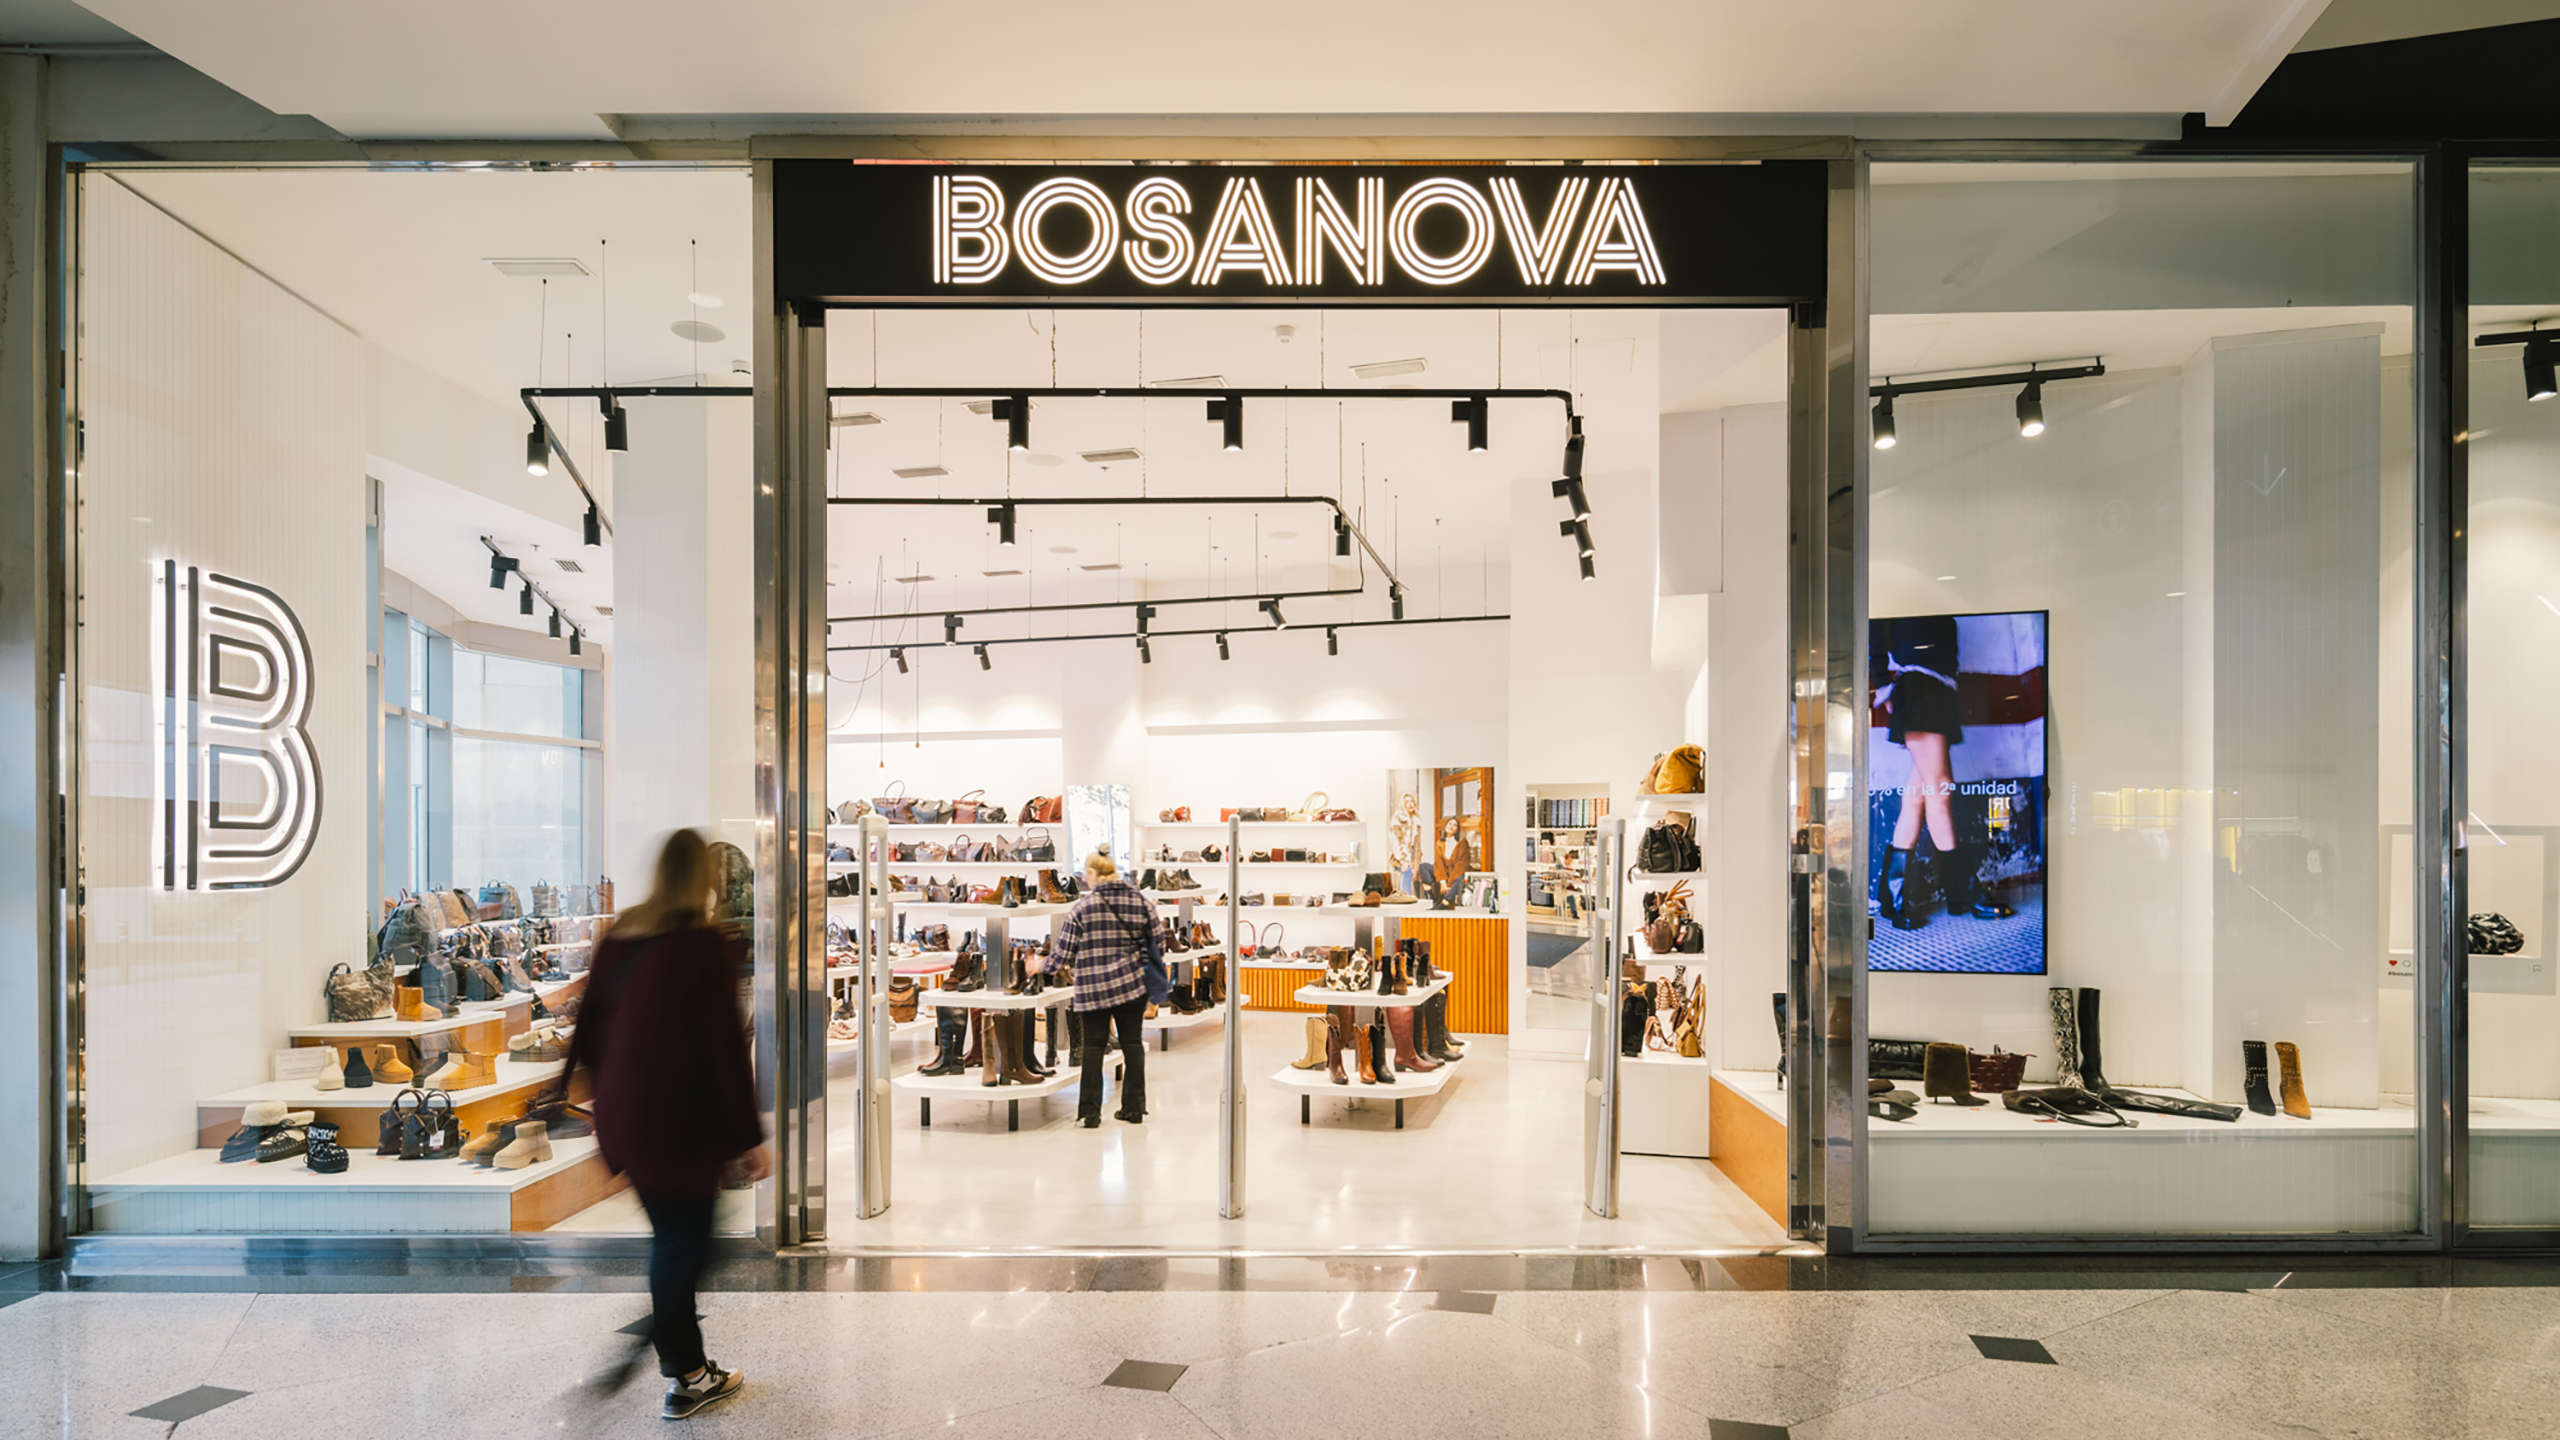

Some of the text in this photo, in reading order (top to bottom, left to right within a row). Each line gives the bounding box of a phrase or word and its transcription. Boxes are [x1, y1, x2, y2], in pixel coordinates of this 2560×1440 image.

[932, 175, 1667, 285] BOSANOVA
[153, 559, 324, 892] B
[1897, 785, 1916, 795] en
[1921, 781, 1938, 795] la
[1961, 780, 2018, 796] unidad
